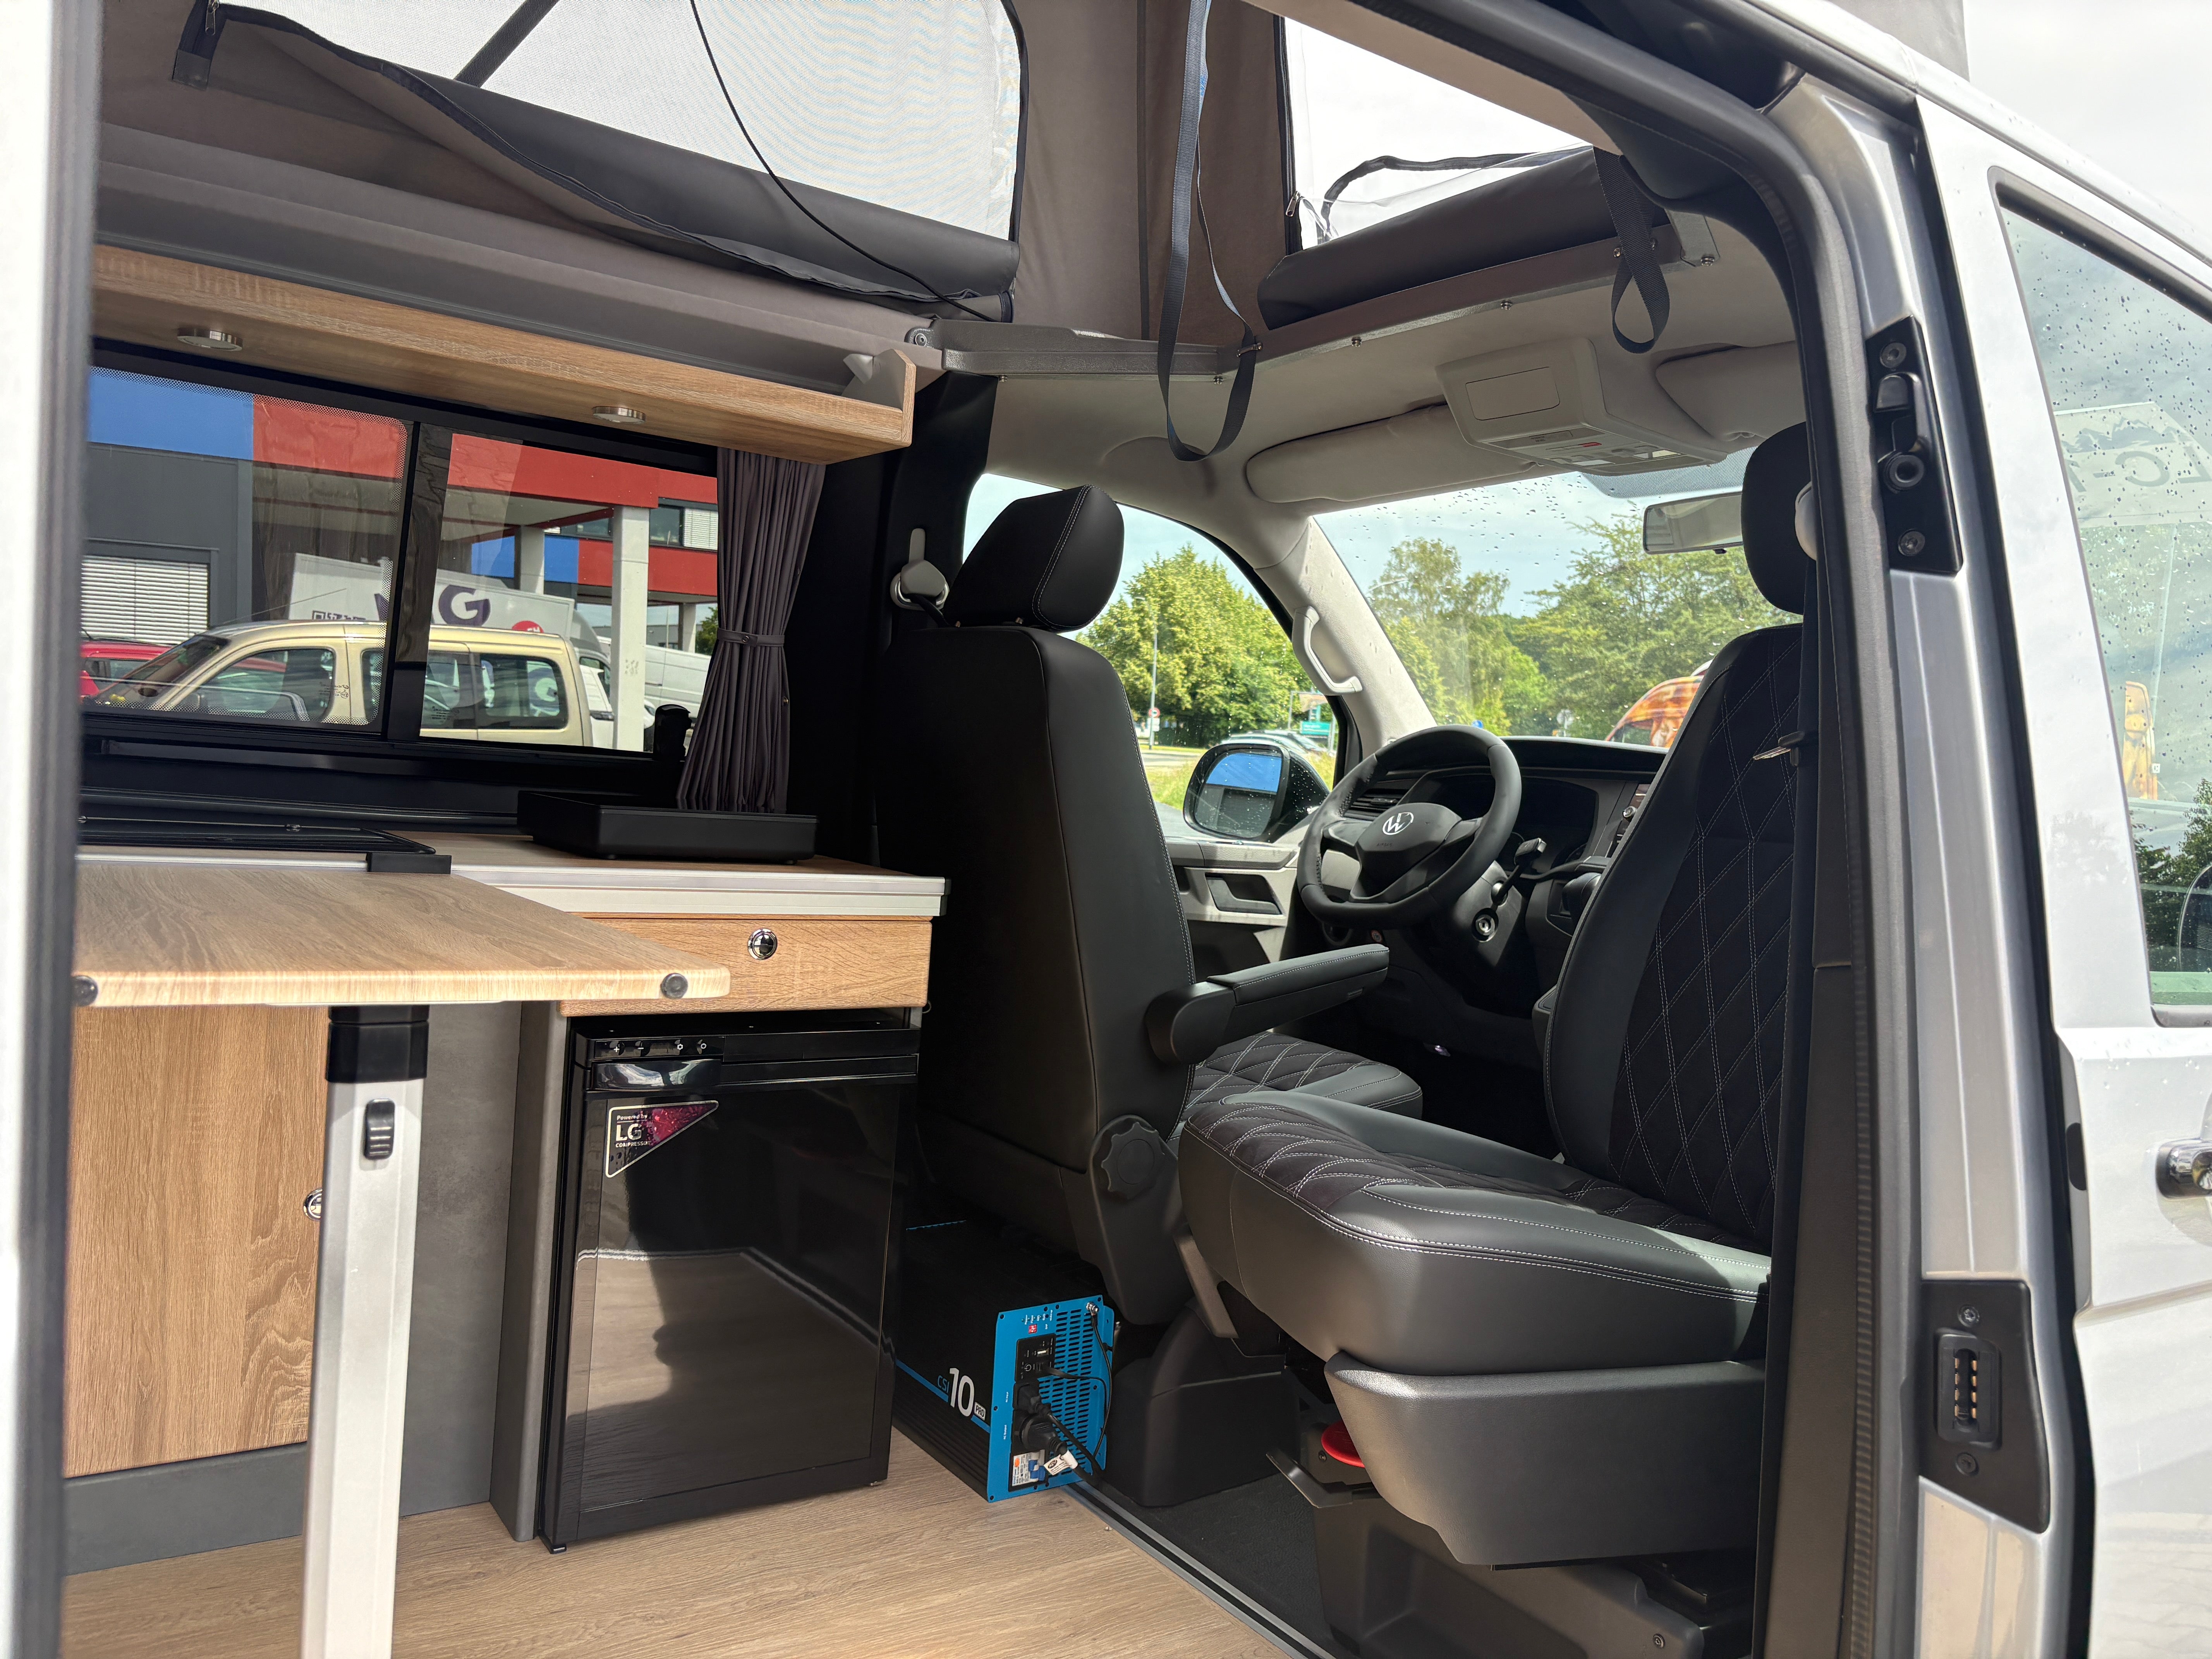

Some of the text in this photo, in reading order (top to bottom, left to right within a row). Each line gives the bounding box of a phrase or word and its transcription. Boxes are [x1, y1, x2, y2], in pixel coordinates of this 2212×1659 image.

[616, 1123, 642, 1141] LG
[938, 1368, 985, 1417] CSI 10 PRO
